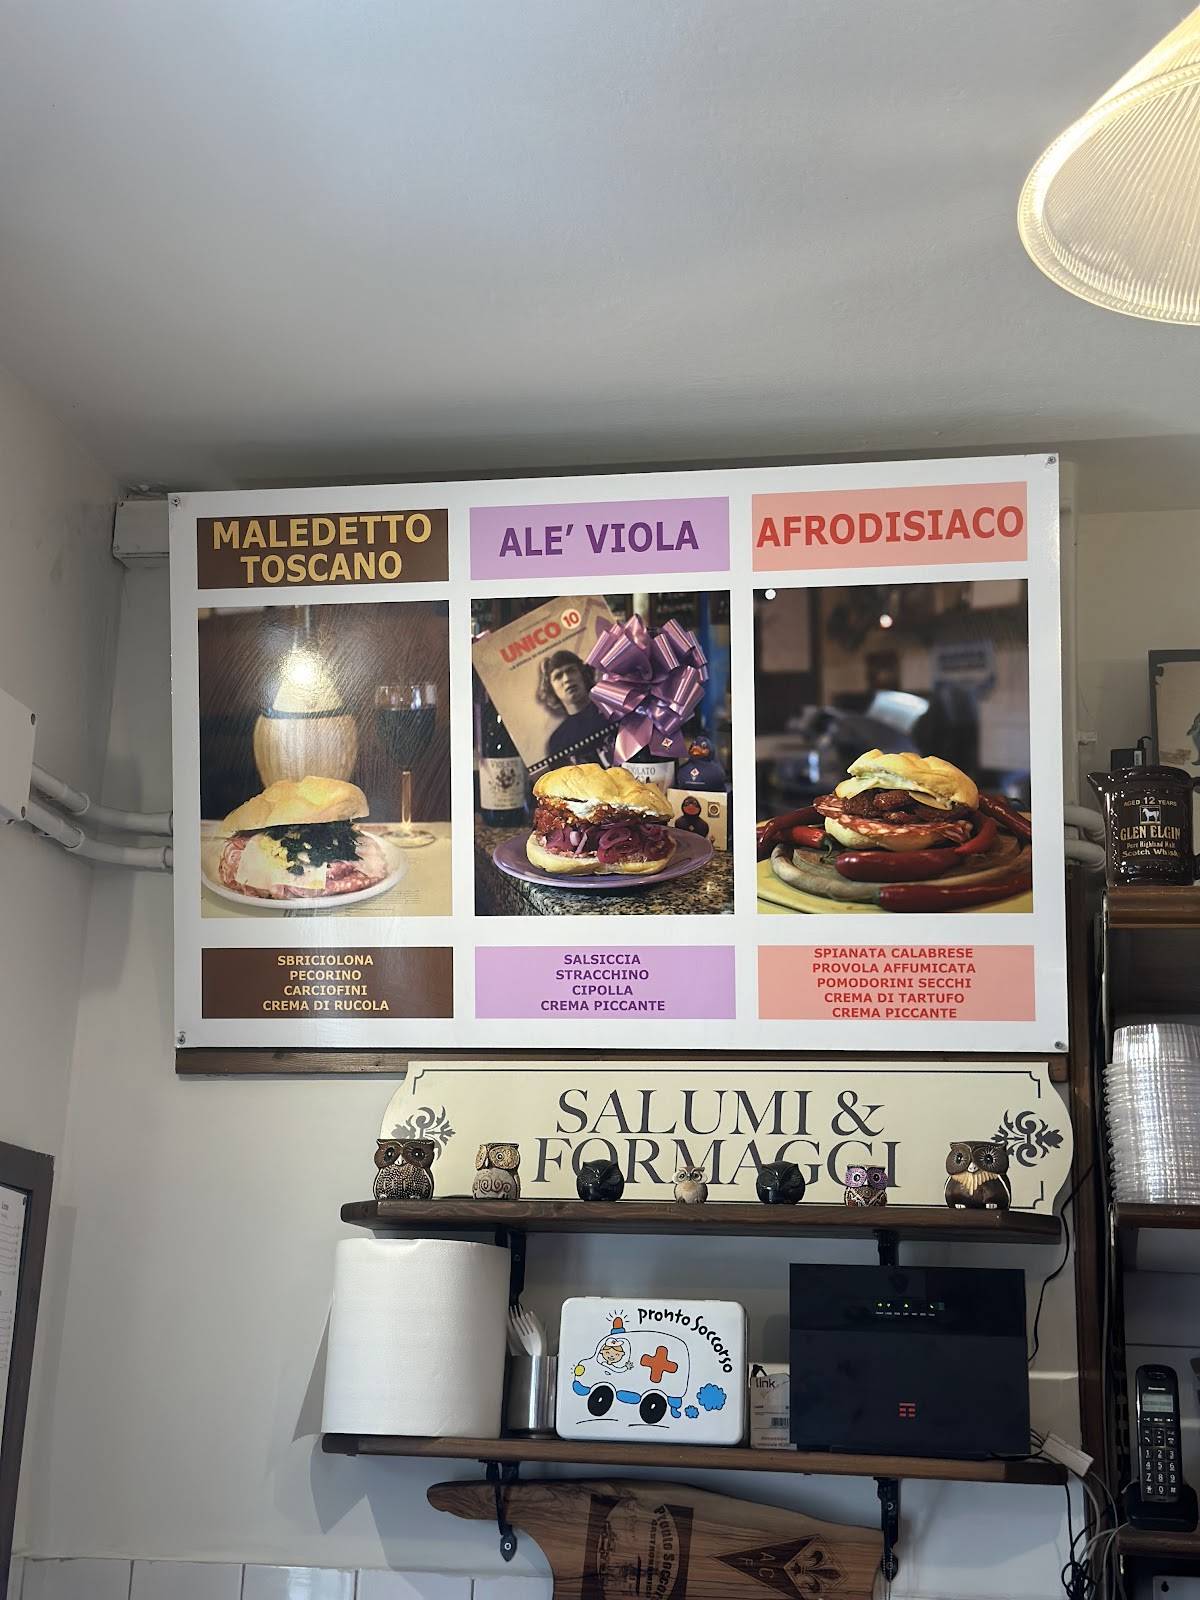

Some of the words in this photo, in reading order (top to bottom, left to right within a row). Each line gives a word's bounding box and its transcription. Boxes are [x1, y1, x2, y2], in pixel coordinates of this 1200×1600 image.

[213, 513, 432, 550] MALEDETTO
[756, 506, 1025, 548] AFRODISIACO
[585, 520, 700, 555] VIOLA
[240, 550, 403, 585] TOSCANO
[499, 621, 562, 664] UNICO
[563, 610, 581, 628] 10
[1143, 796, 1156, 804] 12
[1158, 799, 1177, 807] YEARS
[1120, 824, 1147, 840] GLEN
[1150, 825, 1181, 840] ELGIN
[1122, 848, 1151, 858] Scotch
[814, 947, 887, 959] SPIANATA
[891, 948, 973, 959] CALABRESE
[277, 954, 374, 966] SBRICIOLONA
[564, 954, 641, 965] SALSICCIA
[555, 969, 649, 980] STRACCHINO
[812, 963, 879, 974] PROVOLA
[883, 963, 976, 974] AFFUMICATA
[290, 970, 362, 981] PECORINO
[817, 978, 914, 988] POMODORINI
[918, 978, 972, 989] SECCHI
[283, 985, 368, 996] CARCIOFINI
[572, 985, 633, 996] CIPOLLA
[824, 992, 873, 1003] CREMA
[877, 993, 894, 1003] DI
[899, 993, 965, 1004] TARTUFO
[262, 1000, 310, 1011] CREMA
[313, 1000, 330, 1011] DI
[334, 1000, 390, 1011] RUCOLA
[540, 1000, 589, 1011] CREMA
[594, 1000, 665, 1011] PICCANTE
[832, 1007, 881, 1018] CREMA
[885, 1008, 957, 1019] PICCANTE
[556, 1088, 813, 1136] SALUMI
[831, 1090, 885, 1137] &
[690, 1315, 733, 1373] Soccorso
